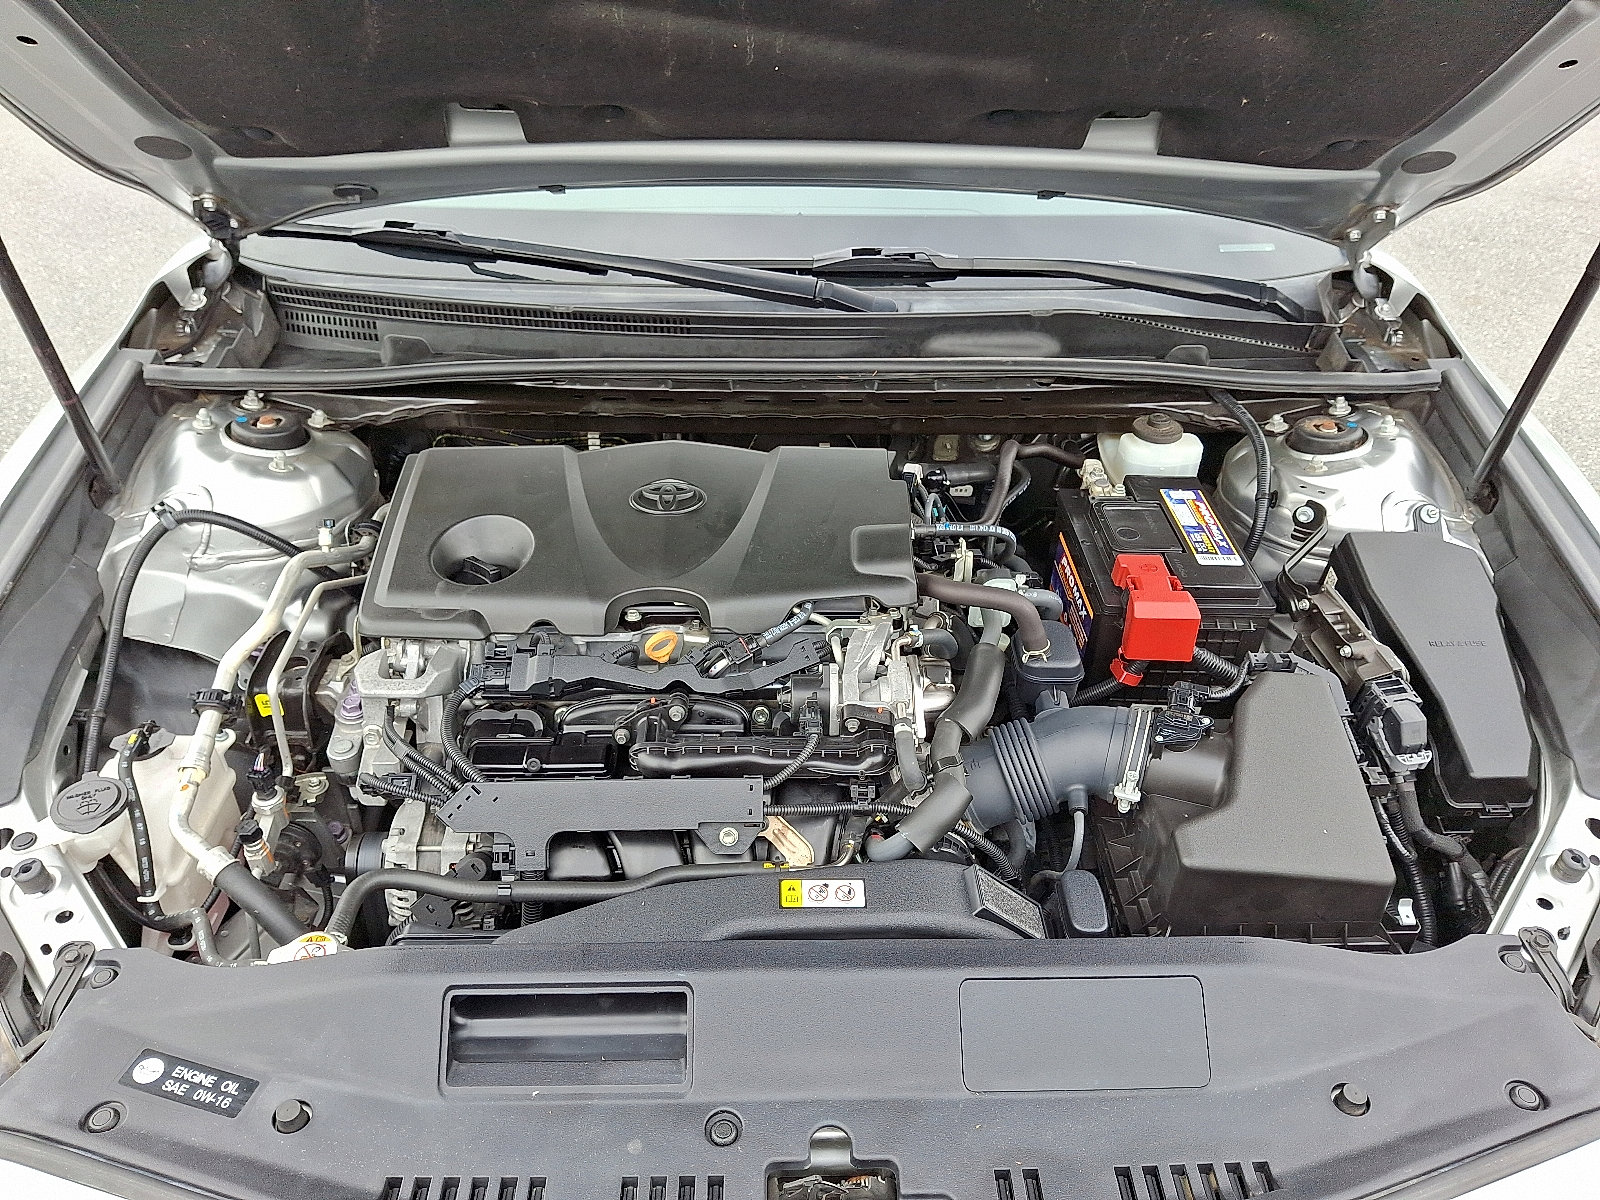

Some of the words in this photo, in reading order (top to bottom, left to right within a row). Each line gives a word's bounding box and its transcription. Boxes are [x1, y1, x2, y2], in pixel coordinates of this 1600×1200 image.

[1061, 556, 1088, 620] PROMAX
[161, 1079, 191, 1096] SAE
[192, 1088, 233, 1109] 0W-16
[171, 1065, 219, 1088] ENGINE
[220, 1080, 240, 1096] OIL
